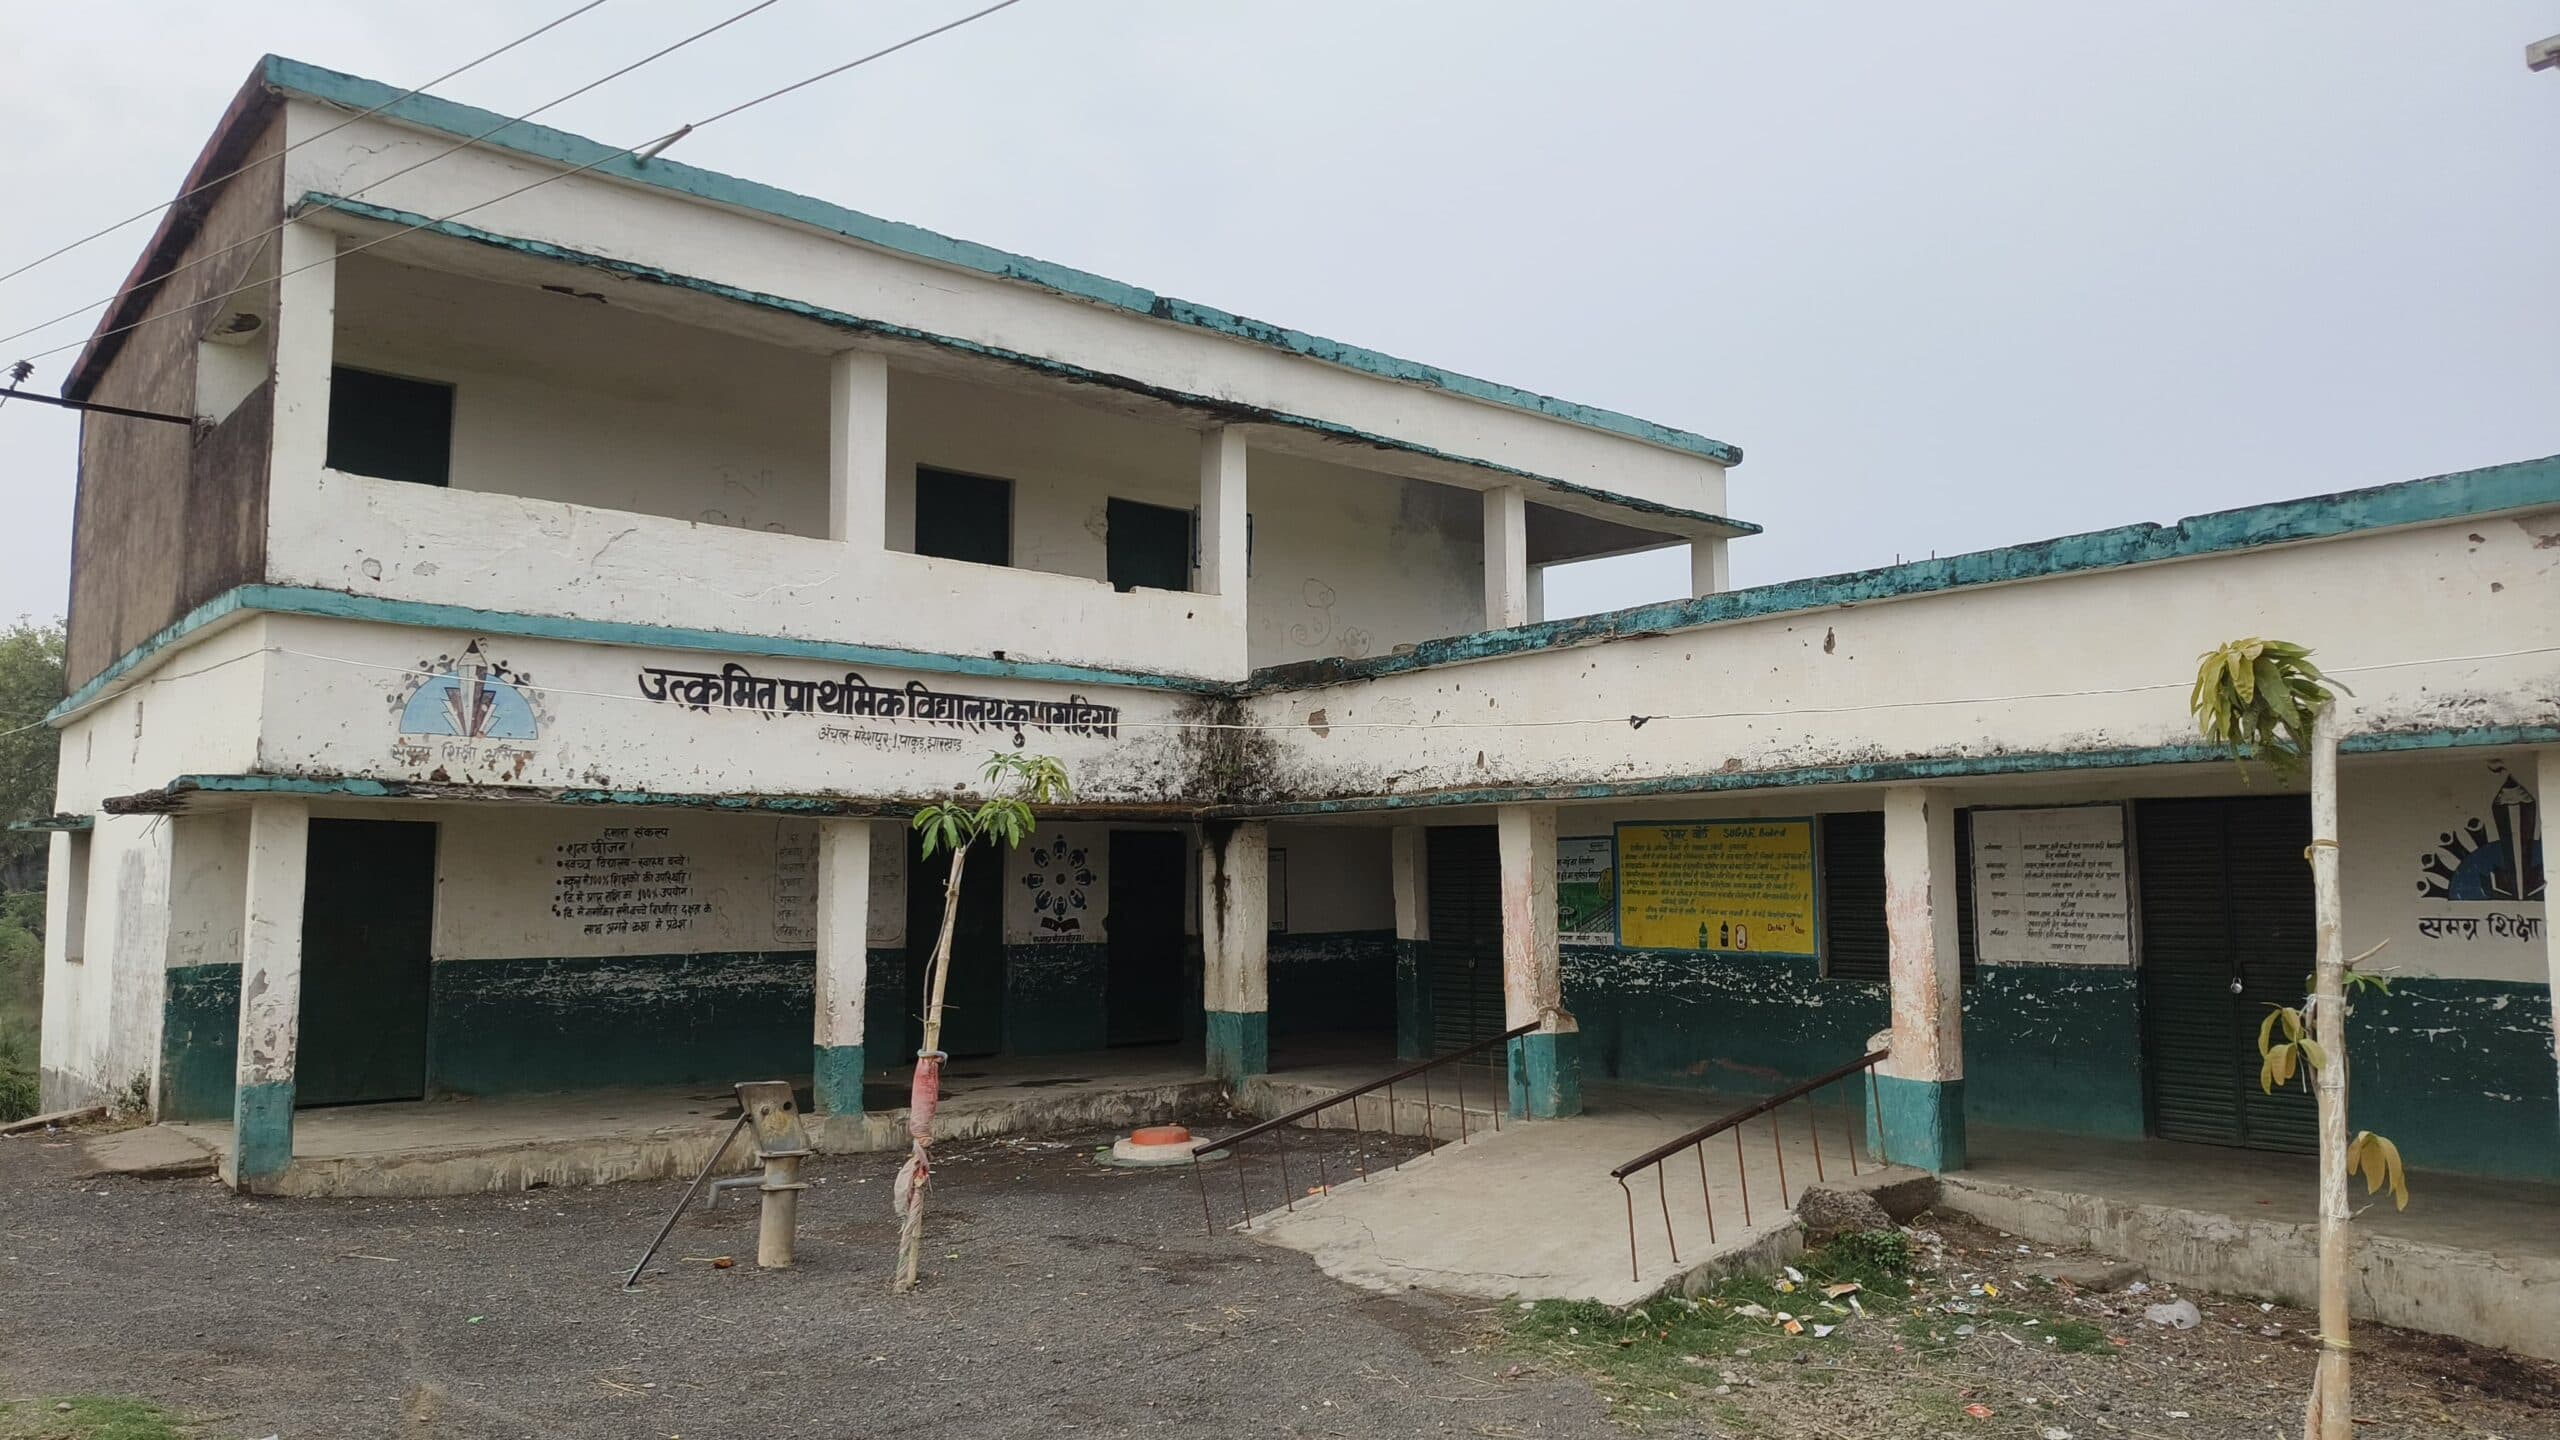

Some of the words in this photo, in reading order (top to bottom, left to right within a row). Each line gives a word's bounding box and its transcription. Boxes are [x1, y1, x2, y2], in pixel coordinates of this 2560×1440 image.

[638, 663, 777, 721] उत्क्रमित
[777, 672, 905, 725] प्राथमिक
[904, 680, 1005, 734] विद्यालय
[2418, 917, 2480, 940] समग्र
[2486, 913, 2542, 942] शिक्षा
